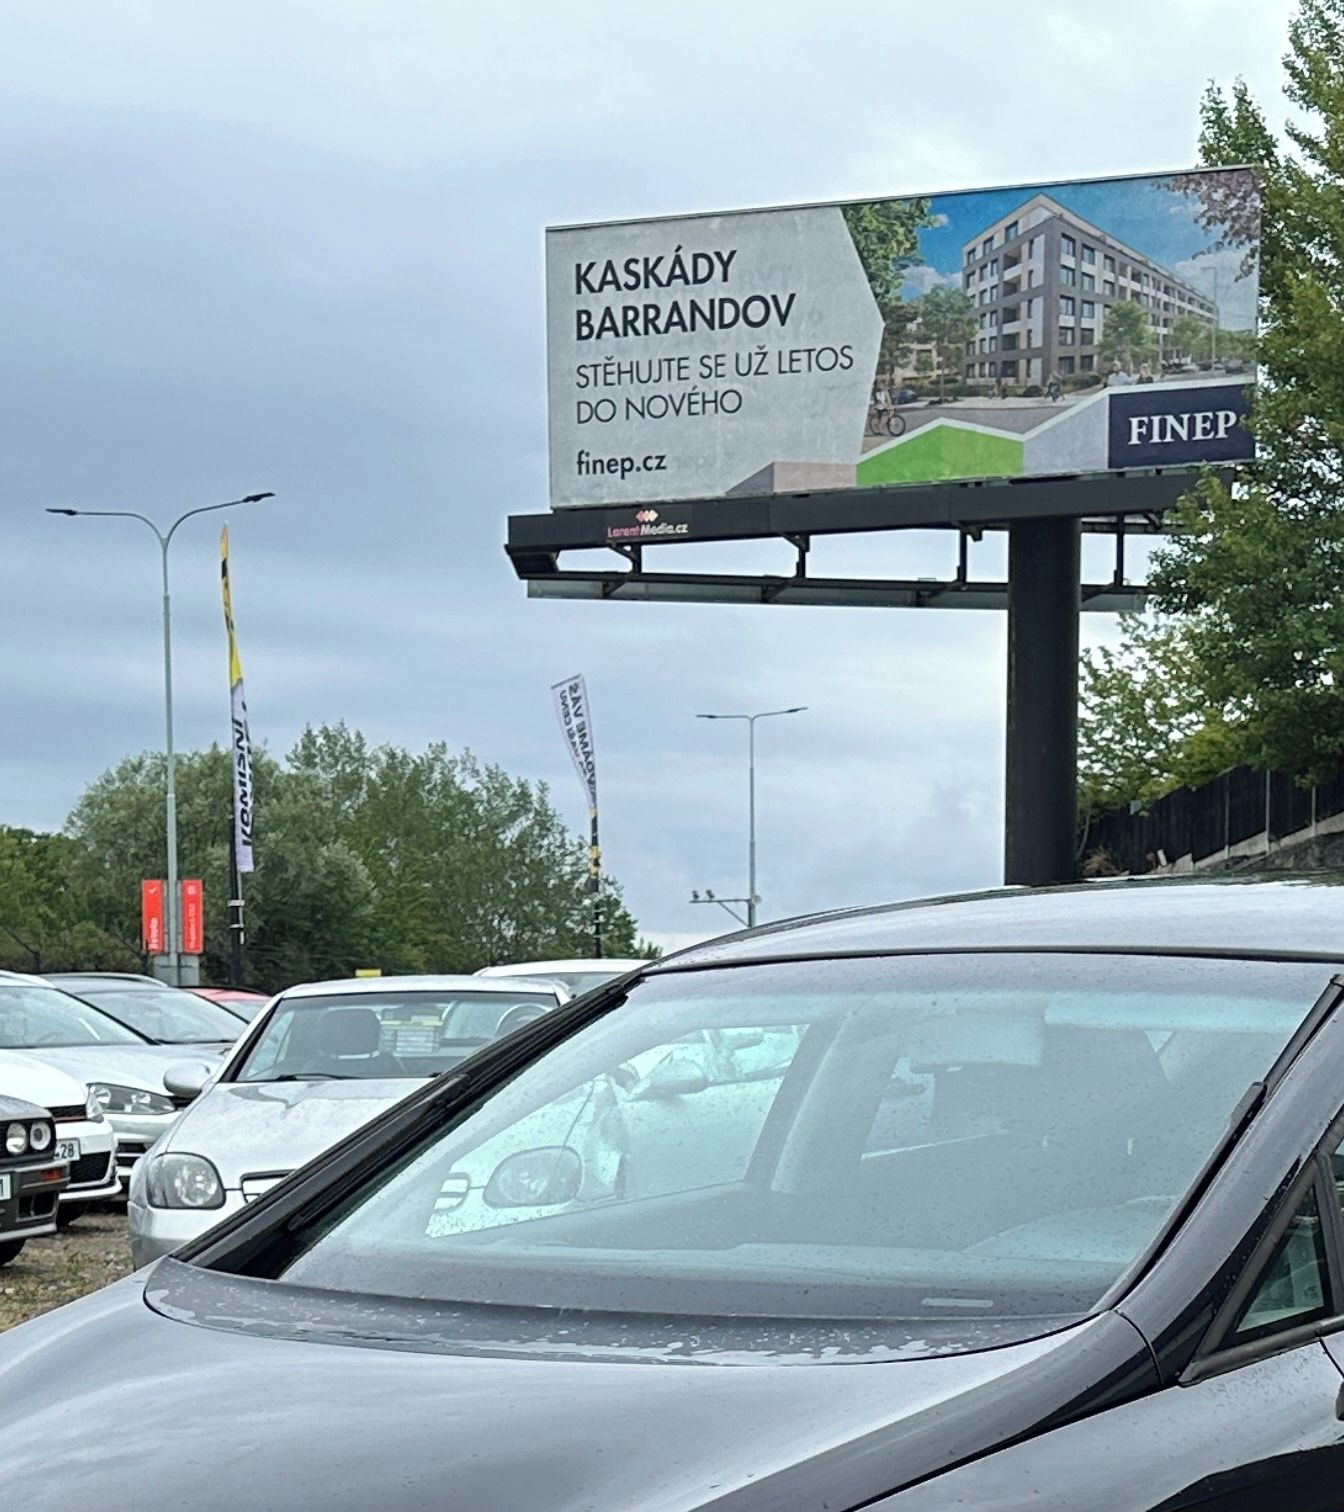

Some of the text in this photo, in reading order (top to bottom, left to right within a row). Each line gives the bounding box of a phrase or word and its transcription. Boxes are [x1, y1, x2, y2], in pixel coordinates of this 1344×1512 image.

[575, 245, 737, 294] KASKÁDY
[576, 293, 796, 340] BARRANDOV
[576, 344, 854, 389] STĚHUJTE SE UŽ LETOS
[576, 385, 743, 424] DO NOVÉHO
[1128, 410, 1238, 446] FINEP
[576, 450, 667, 480] finep.cz
